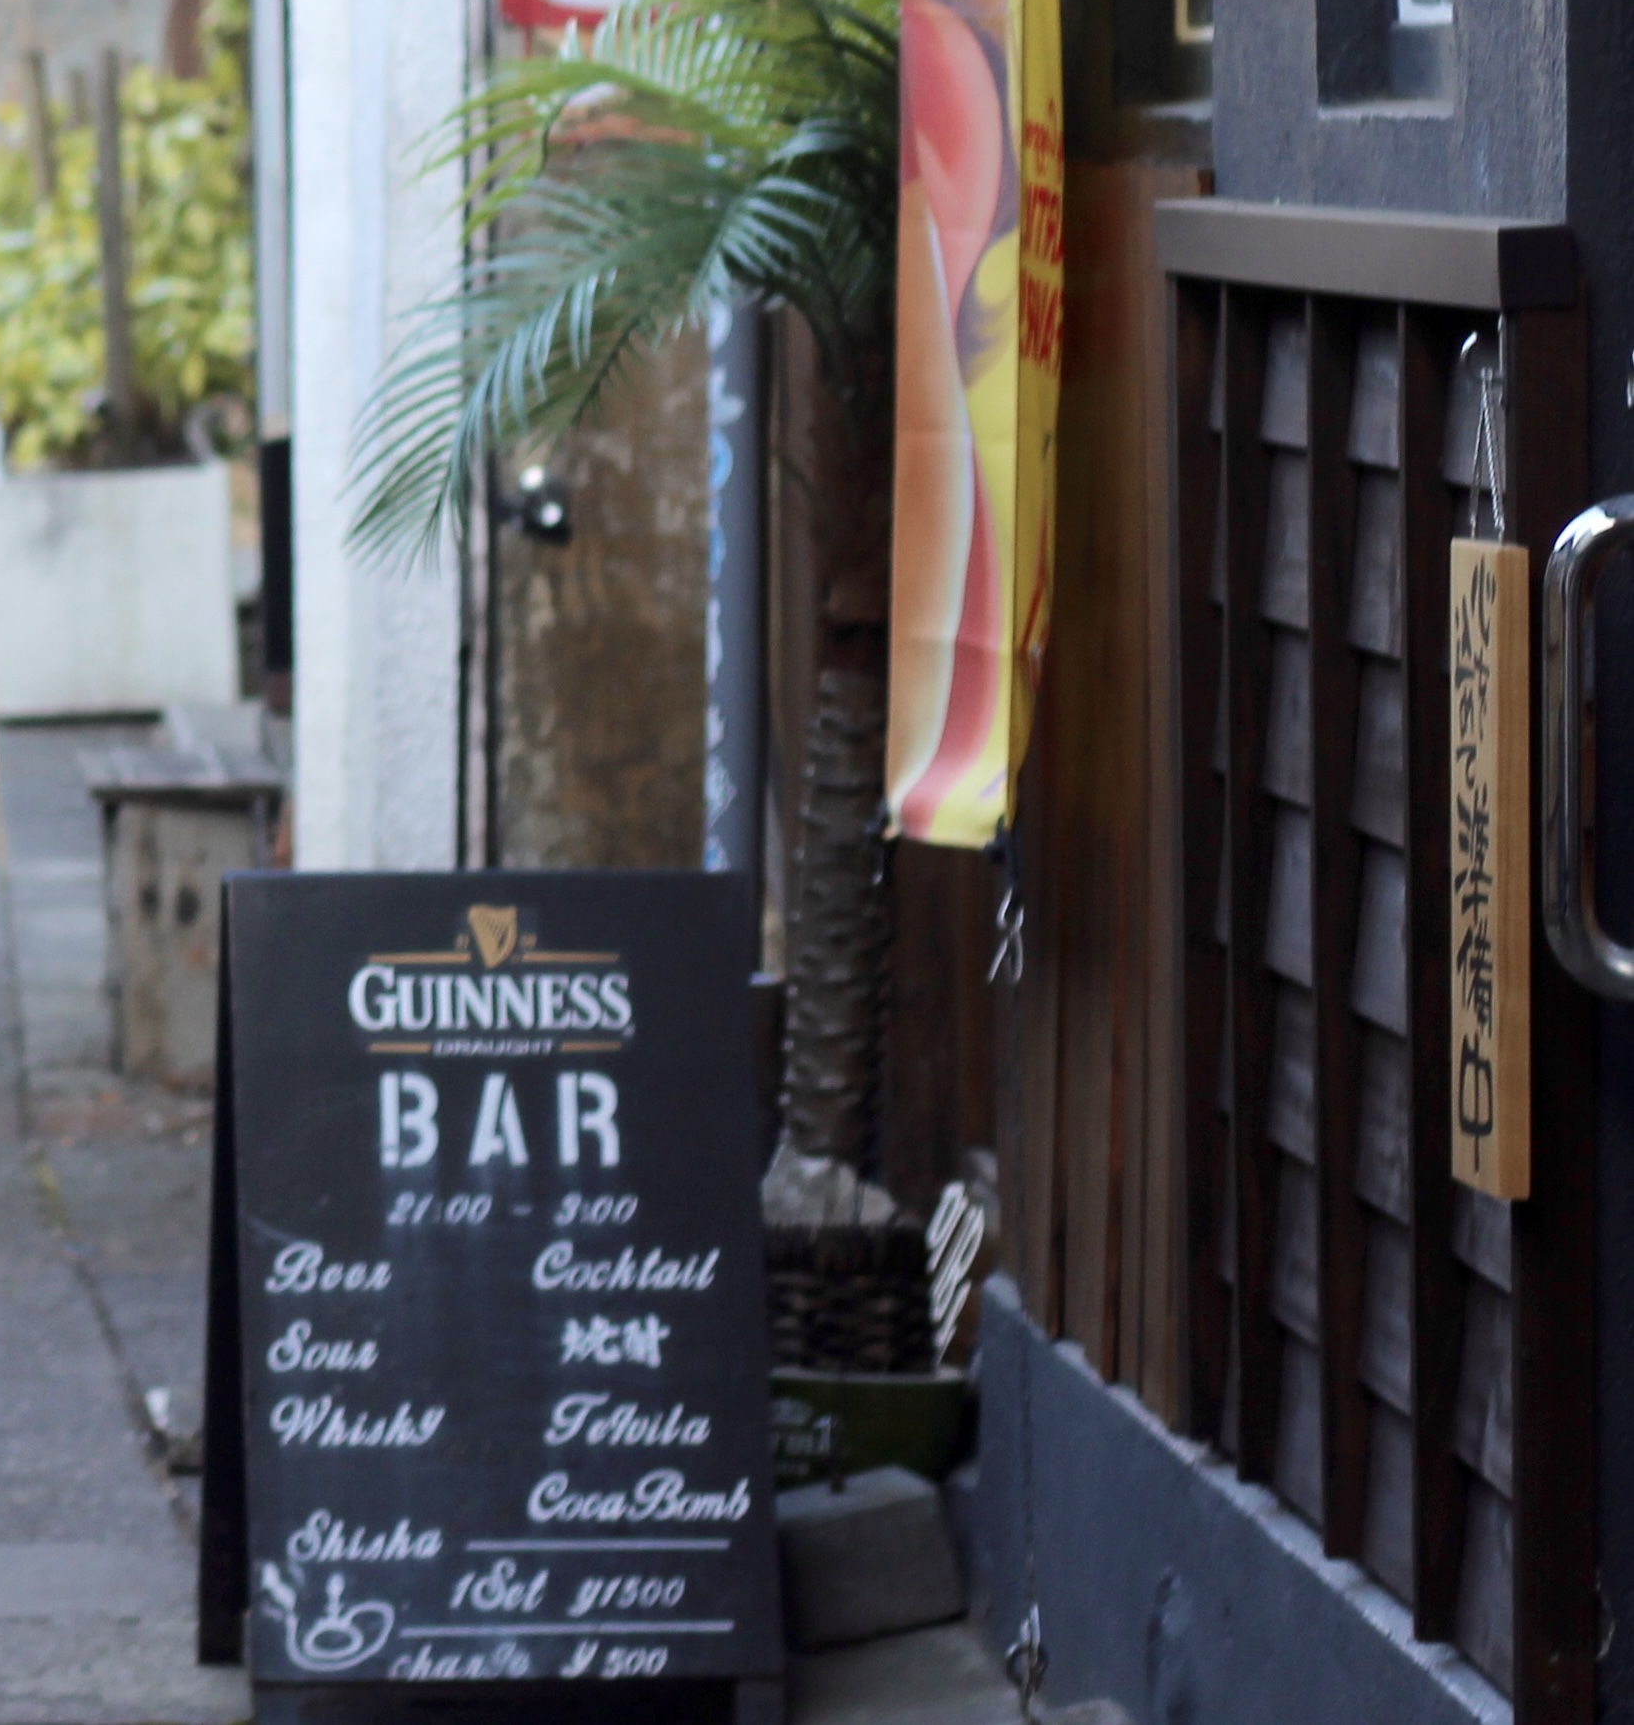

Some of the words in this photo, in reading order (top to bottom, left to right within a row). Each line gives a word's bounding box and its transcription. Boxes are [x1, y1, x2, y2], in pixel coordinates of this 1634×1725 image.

[348, 964, 633, 1032] GUINNESS
[378, 1072, 621, 1169] BAR
[265, 1240, 392, 1294] Beer
[532, 1239, 721, 1292] Cocktail
[266, 1319, 379, 1372] Sour
[286, 1509, 444, 1564] Shisha
